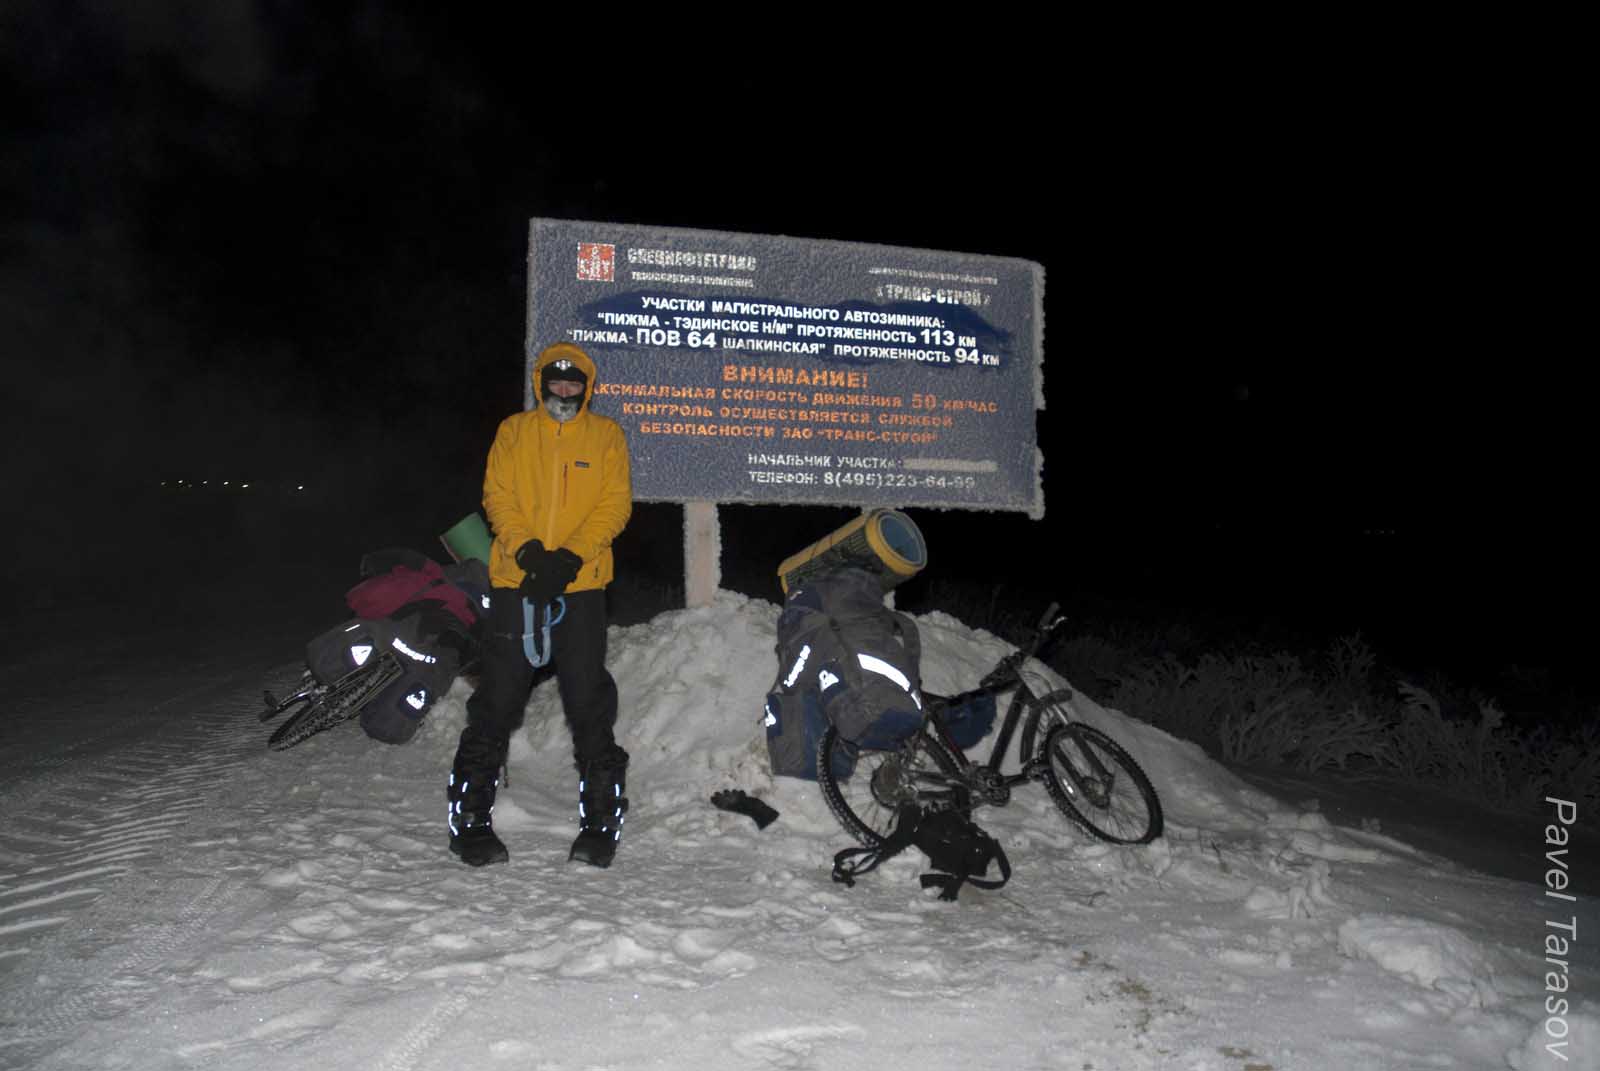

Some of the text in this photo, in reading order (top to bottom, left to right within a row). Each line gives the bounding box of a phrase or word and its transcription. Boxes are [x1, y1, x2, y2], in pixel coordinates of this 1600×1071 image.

[641, 296, 945, 329] УЧАСТКИ МАГИСТРАЛЬНОГО АВТОЗИМНИКА:
[598, 312, 660, 328] “ПИЖМА
[674, 316, 759, 333] ТЭДИНСКОЕ
[797, 324, 916, 344] ПРОТЯЖЕННОСТЬ
[920, 328, 955, 346] 113
[636, 329, 681, 347] ПОВ
[687, 331, 717, 348] 64
[722, 337, 826, 355] ШАПКИНСКАЯ"
[833, 344, 951, 363] ПРОТЯЖЕННОСТЬ
[954, 349, 980, 365] 94
[722, 364, 868, 389] ВНИМАНИЕ!
[593, 383, 716, 400] КСИМАЛЬНАЯ
[721, 388, 808, 404] СКОРОСТЬ
[811, 392, 902, 409] ДВИЖЕНИЯ
[911, 392, 937, 409] 50
[623, 402, 954, 428] КОНТРОЛЬ ОСУЩЕСТВЛЯЕТСЯ СЛУЖБОЙ
[640, 420, 775, 438] БЕЗОПАСНОСТИ
[782, 426, 813, 440] ЗАО
[748, 453, 832, 468] НАЧАЛЬНИК
[749, 470, 819, 485] ТЕЛЕФОН:
